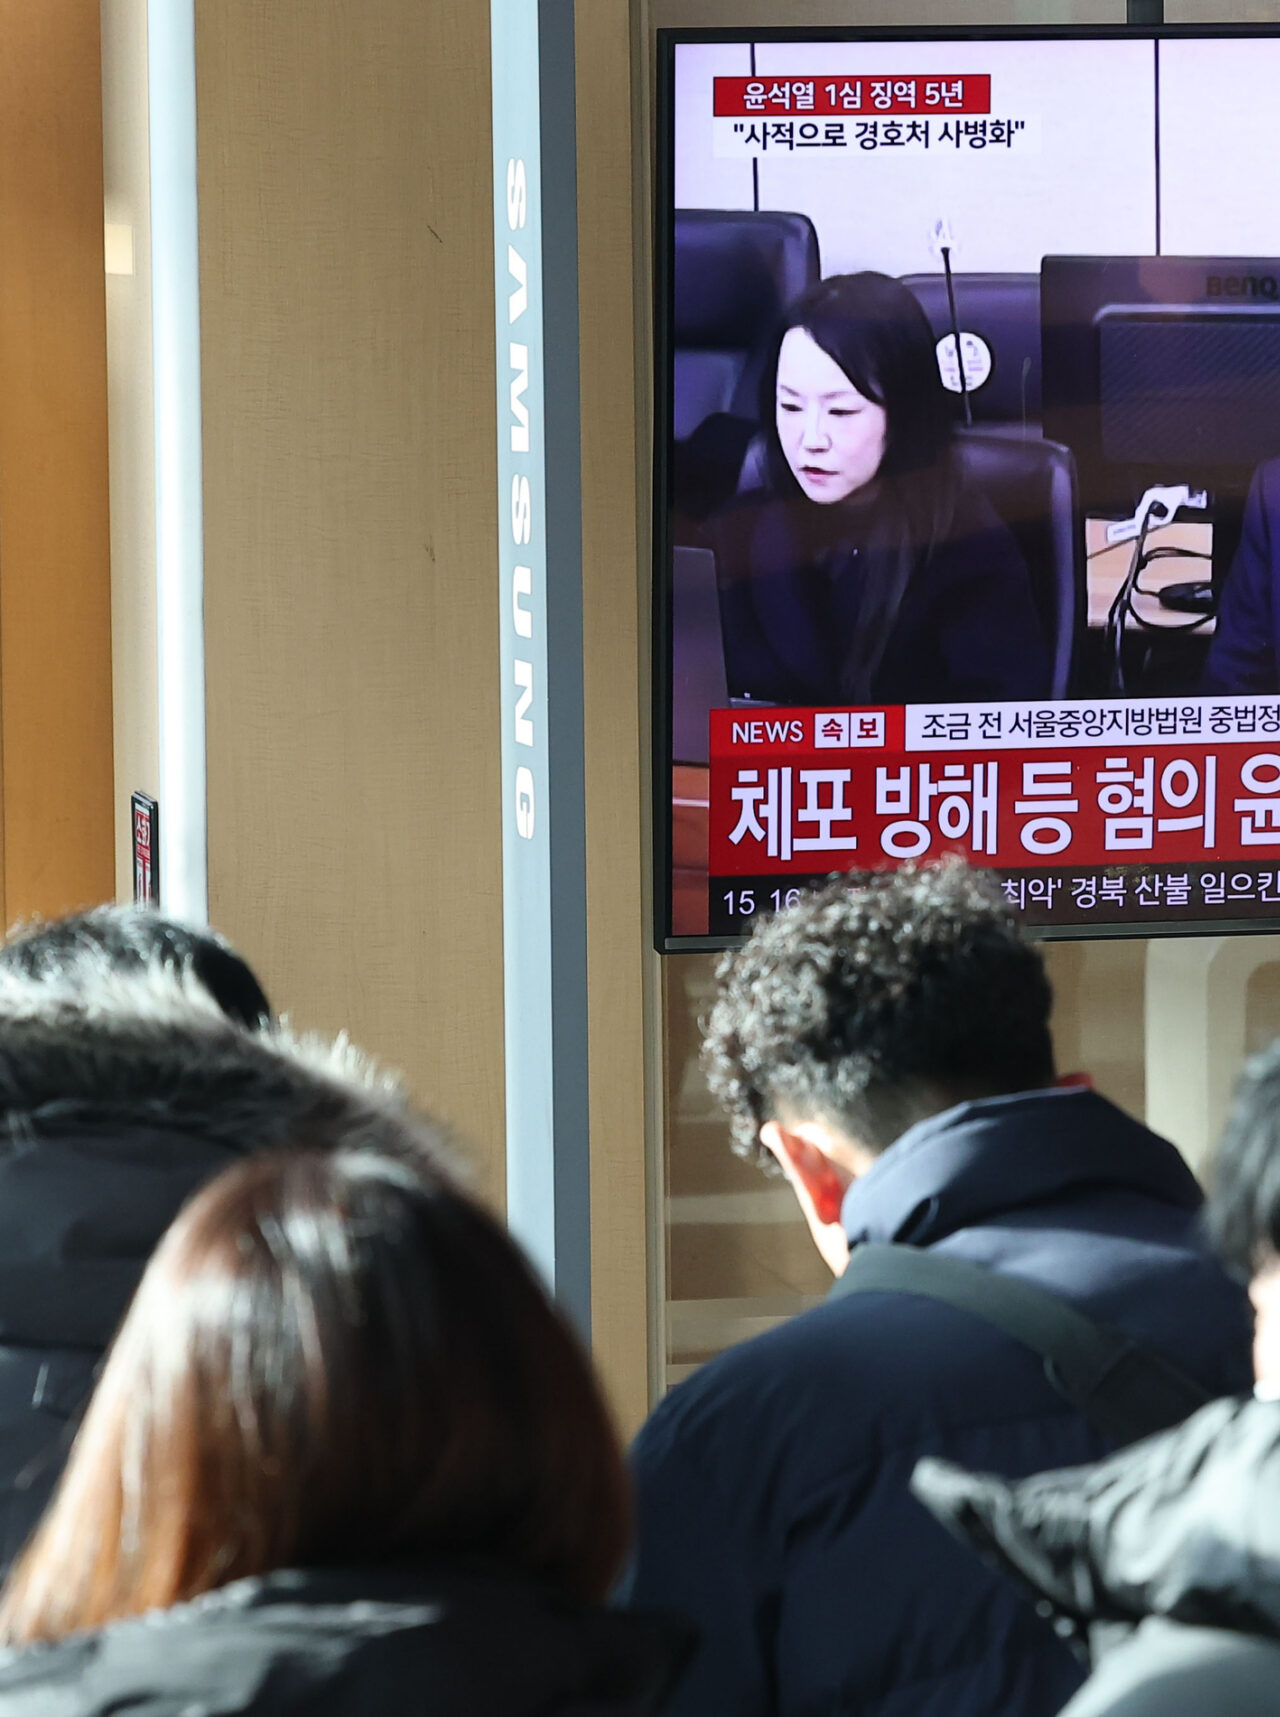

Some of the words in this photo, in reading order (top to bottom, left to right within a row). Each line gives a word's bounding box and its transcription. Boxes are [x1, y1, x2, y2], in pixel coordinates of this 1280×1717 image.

[743, 81, 816, 110] 윤석열
[825, 81, 862, 109] 1심
[870, 80, 917, 108] 징역
[924, 80, 963, 108] 5년
[734, 121, 847, 150] "사적으로
[855, 120, 930, 150] 경호처
[938, 119, 1025, 149] 사병화"
[504, 157, 536, 842] SAMSUNG
[731, 720, 804, 744] NEWS
[820, 716, 880, 741] 속보
[921, 711, 971, 741] 조금
[978, 711, 1003, 738] 전
[1007, 706, 1203, 739] 서울중앙지방법원
[728, 766, 858, 862] 체포
[875, 761, 999, 859] 방해
[1013, 760, 1080, 856] 등
[1096, 755, 1217, 850] 혐의
[1071, 874, 1128, 908] 경북
[1134, 873, 1192, 906] 산불
